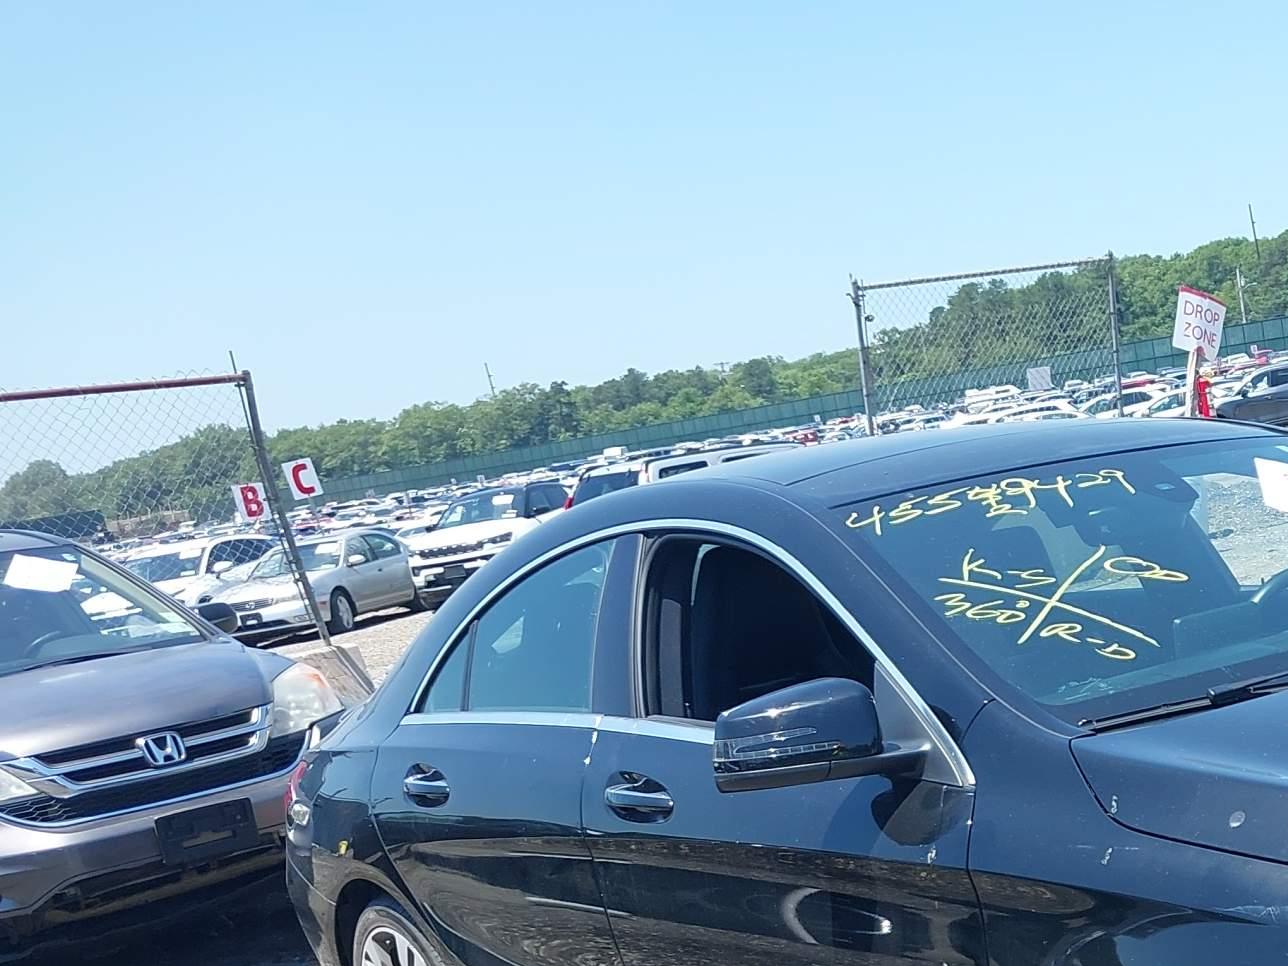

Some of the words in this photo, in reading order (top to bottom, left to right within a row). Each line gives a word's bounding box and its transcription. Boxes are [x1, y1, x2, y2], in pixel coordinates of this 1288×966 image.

[1183, 299, 1220, 327] DROP
[1183, 321, 1217, 349] ZONE
[292, 463, 316, 495] C
[240, 486, 264, 517] B
